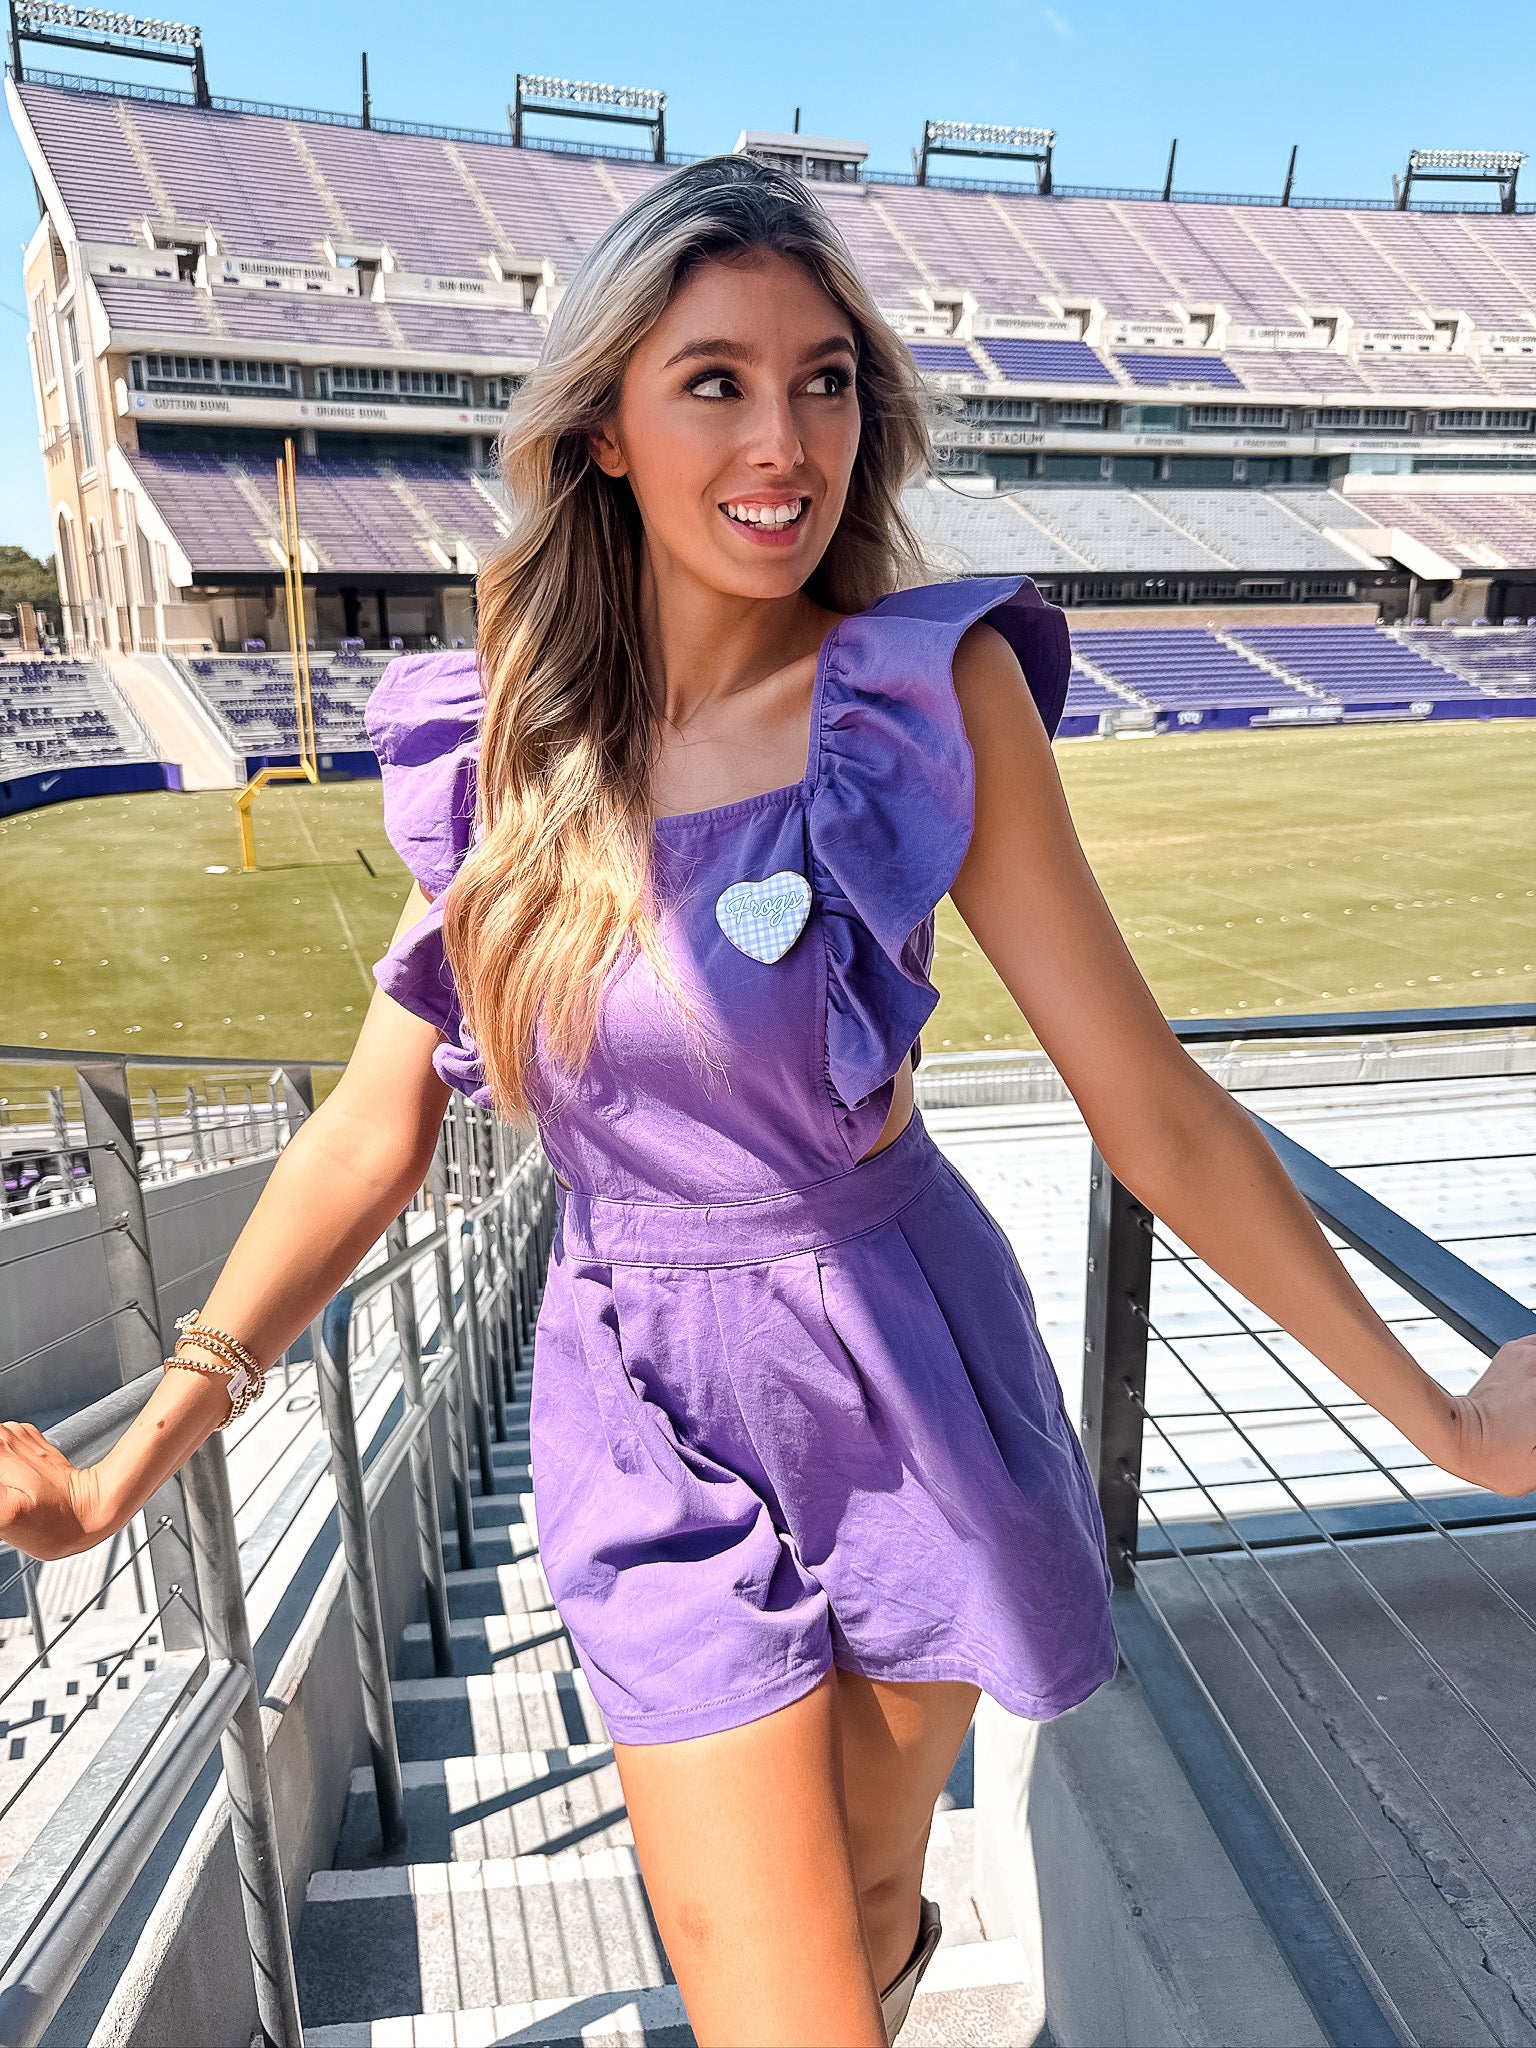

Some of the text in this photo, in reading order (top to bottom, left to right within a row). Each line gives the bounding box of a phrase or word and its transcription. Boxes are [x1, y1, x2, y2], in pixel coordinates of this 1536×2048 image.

[304, 268, 332, 281] BOWL
[459, 282, 486, 294] BOWL
[152, 397, 232, 413] COTTON BOWL
[359, 407, 388, 420] BOWL
[987, 431, 1046, 445] STADIUM
[725, 889, 804, 927] Frogs
